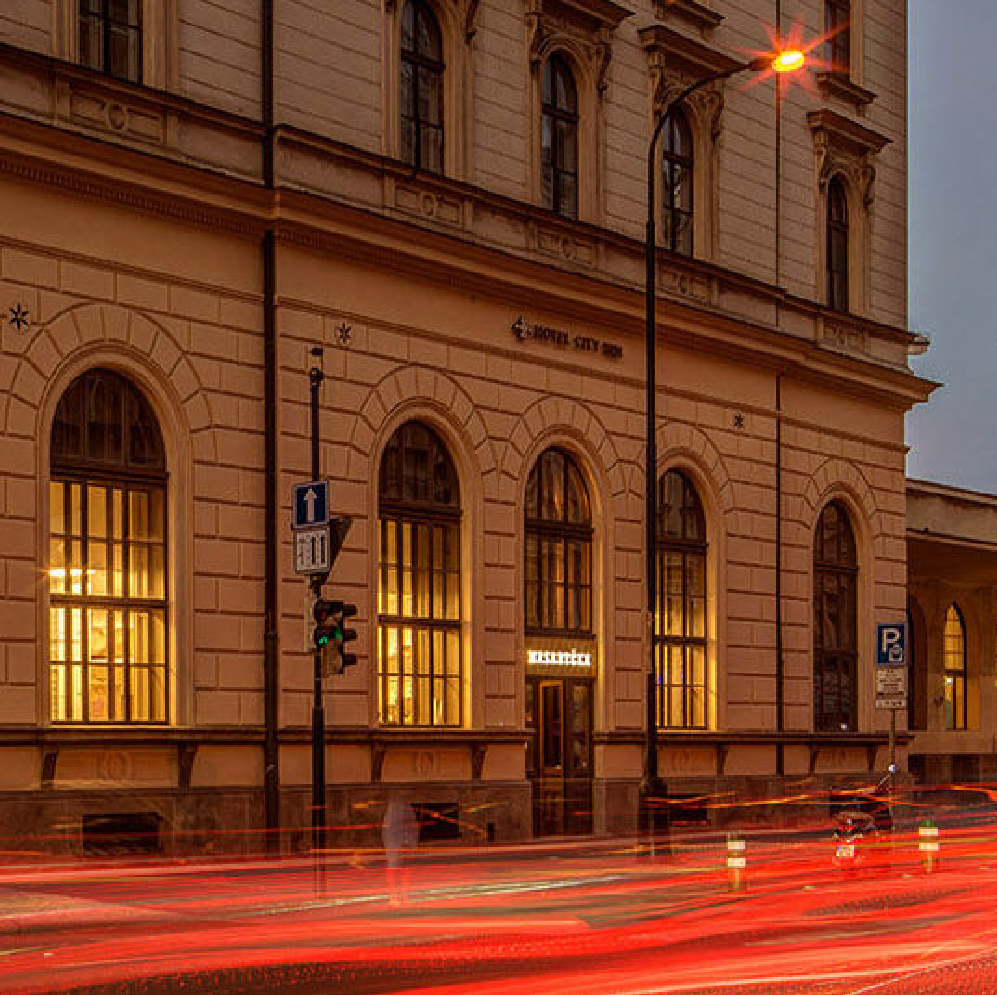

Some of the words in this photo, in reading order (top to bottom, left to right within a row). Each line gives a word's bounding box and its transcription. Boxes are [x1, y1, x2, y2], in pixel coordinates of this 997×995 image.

[534, 323, 569, 346] HOTEL
[574, 336, 599, 352] CITY
[881, 628, 901, 653] P
